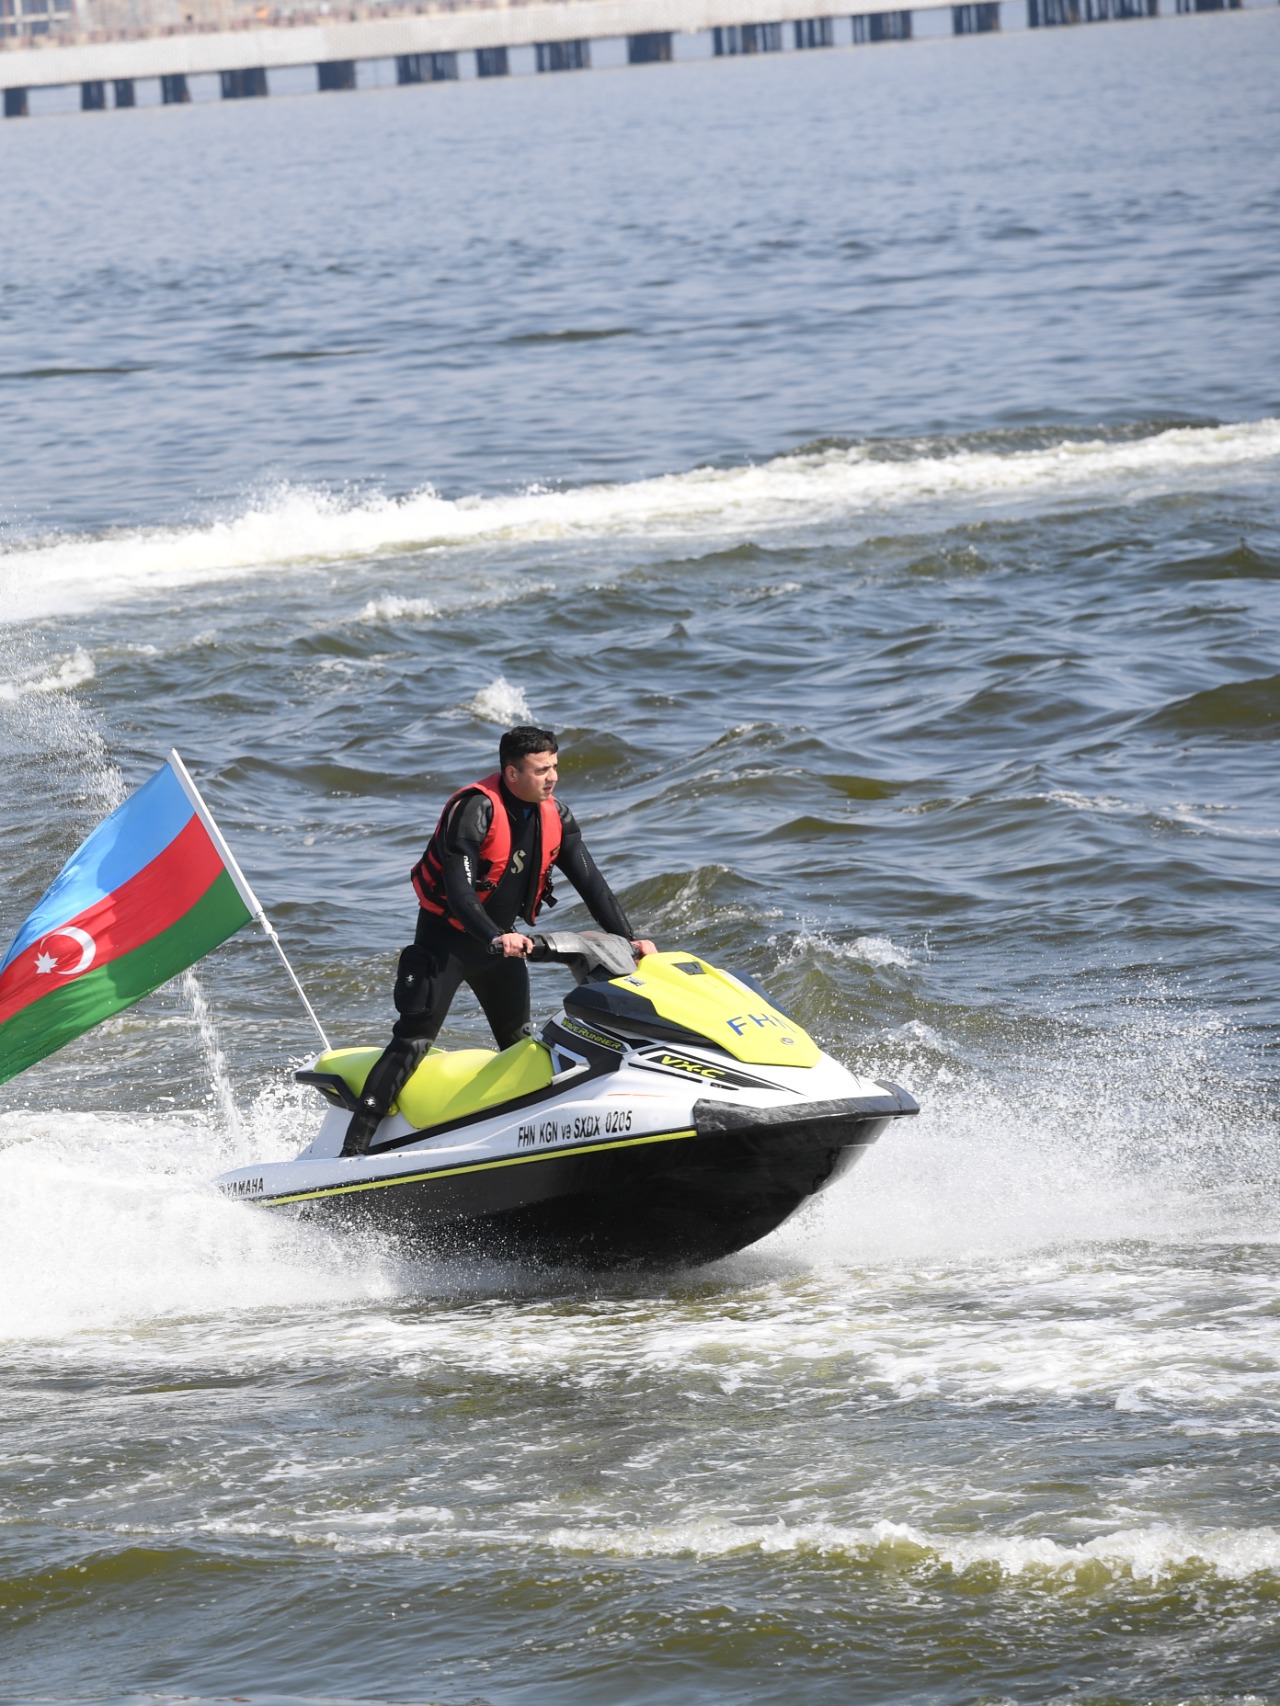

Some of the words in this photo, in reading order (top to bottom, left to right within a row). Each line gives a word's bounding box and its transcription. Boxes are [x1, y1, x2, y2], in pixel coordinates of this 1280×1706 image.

[518, 1125, 535, 1148] FHN
[539, 1121, 558, 1143] KGN
[605, 1110, 632, 1133] 0205
[227, 1177, 264, 1197] YAMAHA
